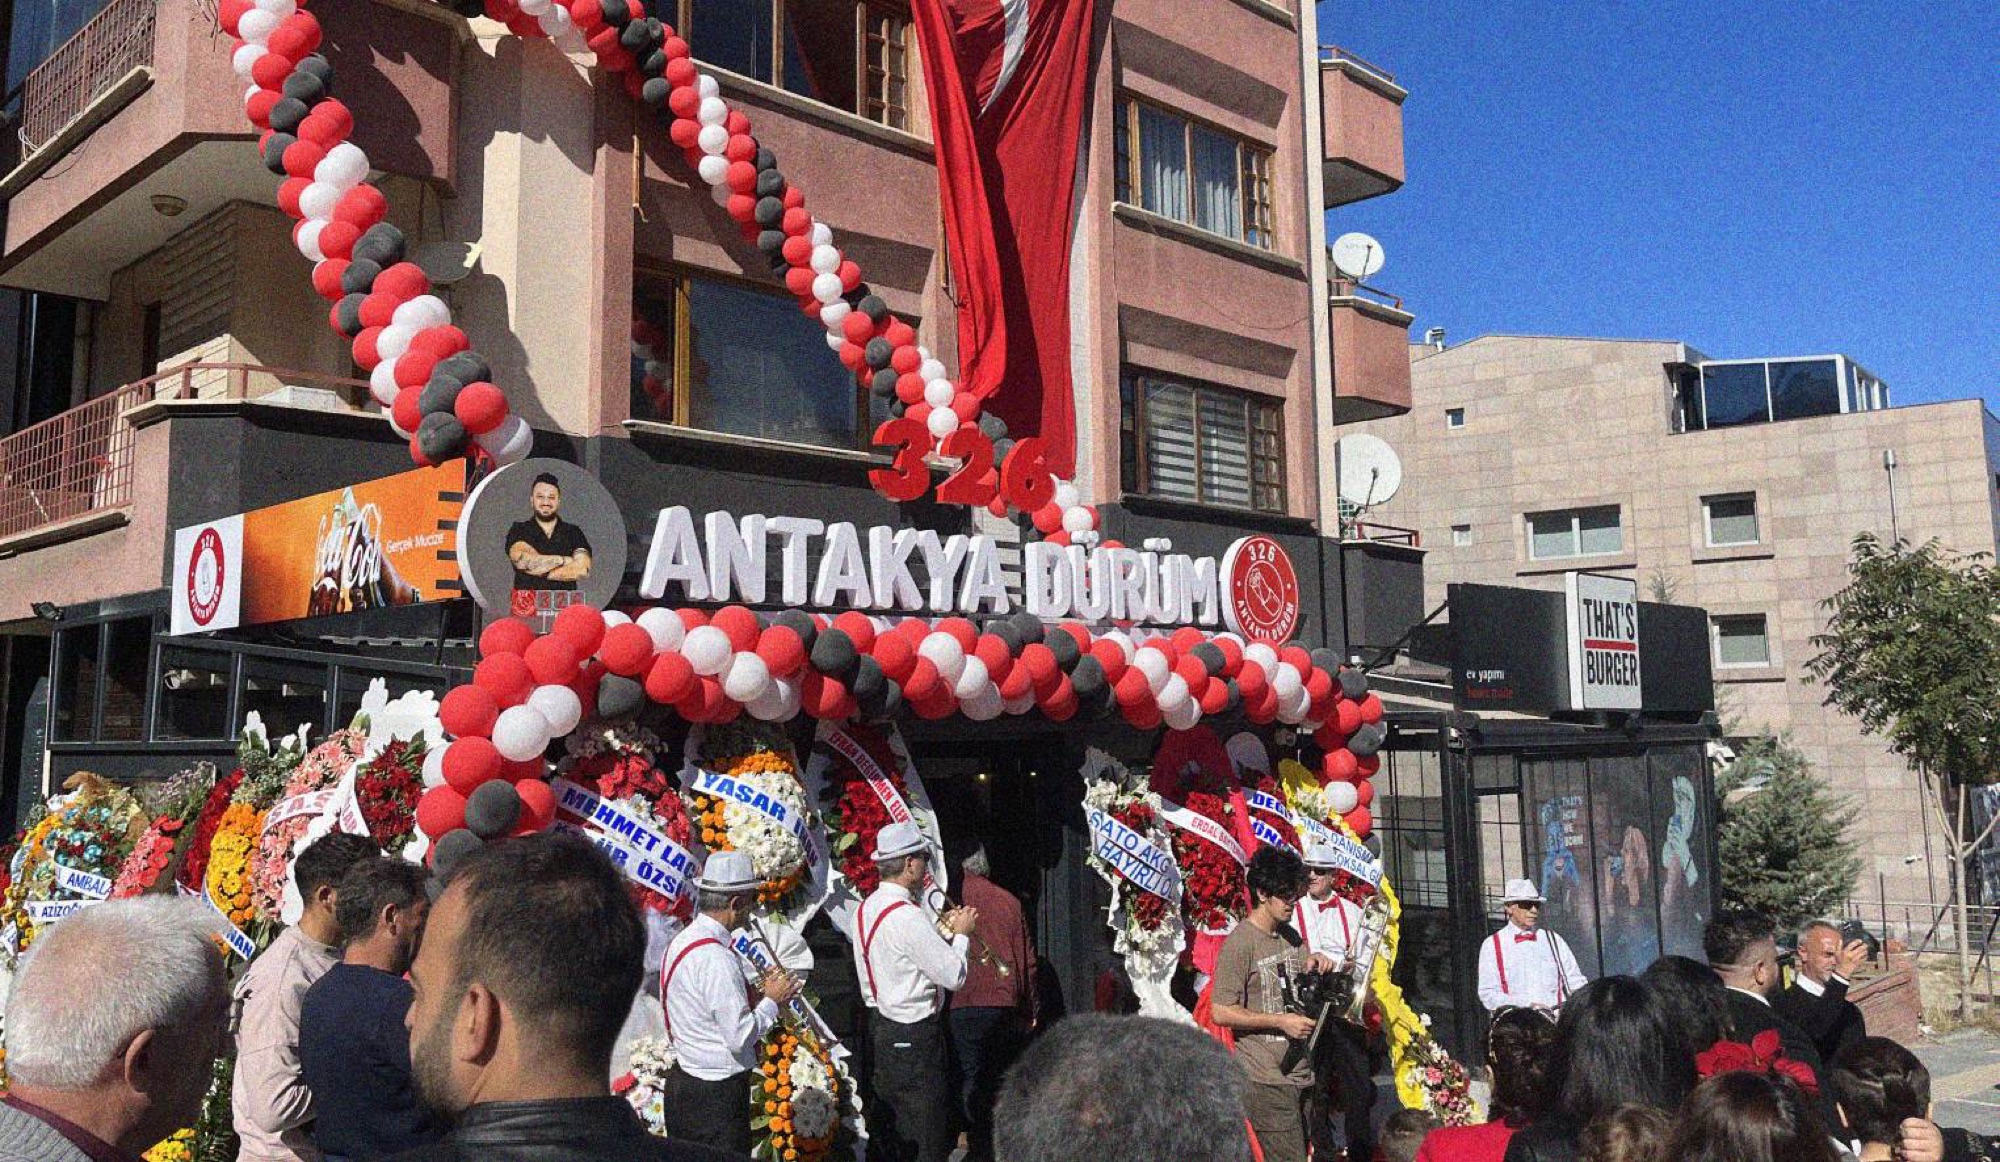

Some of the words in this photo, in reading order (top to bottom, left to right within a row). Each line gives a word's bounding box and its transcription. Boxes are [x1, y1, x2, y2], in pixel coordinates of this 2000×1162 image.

[867, 418, 1056, 513] 326
[639, 505, 1010, 615] ANTAKYA
[1025, 530, 1218, 626] DÜRÜM
[1248, 543, 1276, 562] 326
[1583, 598, 1635, 640] THAT'S
[1586, 650, 1638, 686] BURGER
[561, 787, 661, 852] MEHMET
[1191, 816, 1217, 837] ERDAL
